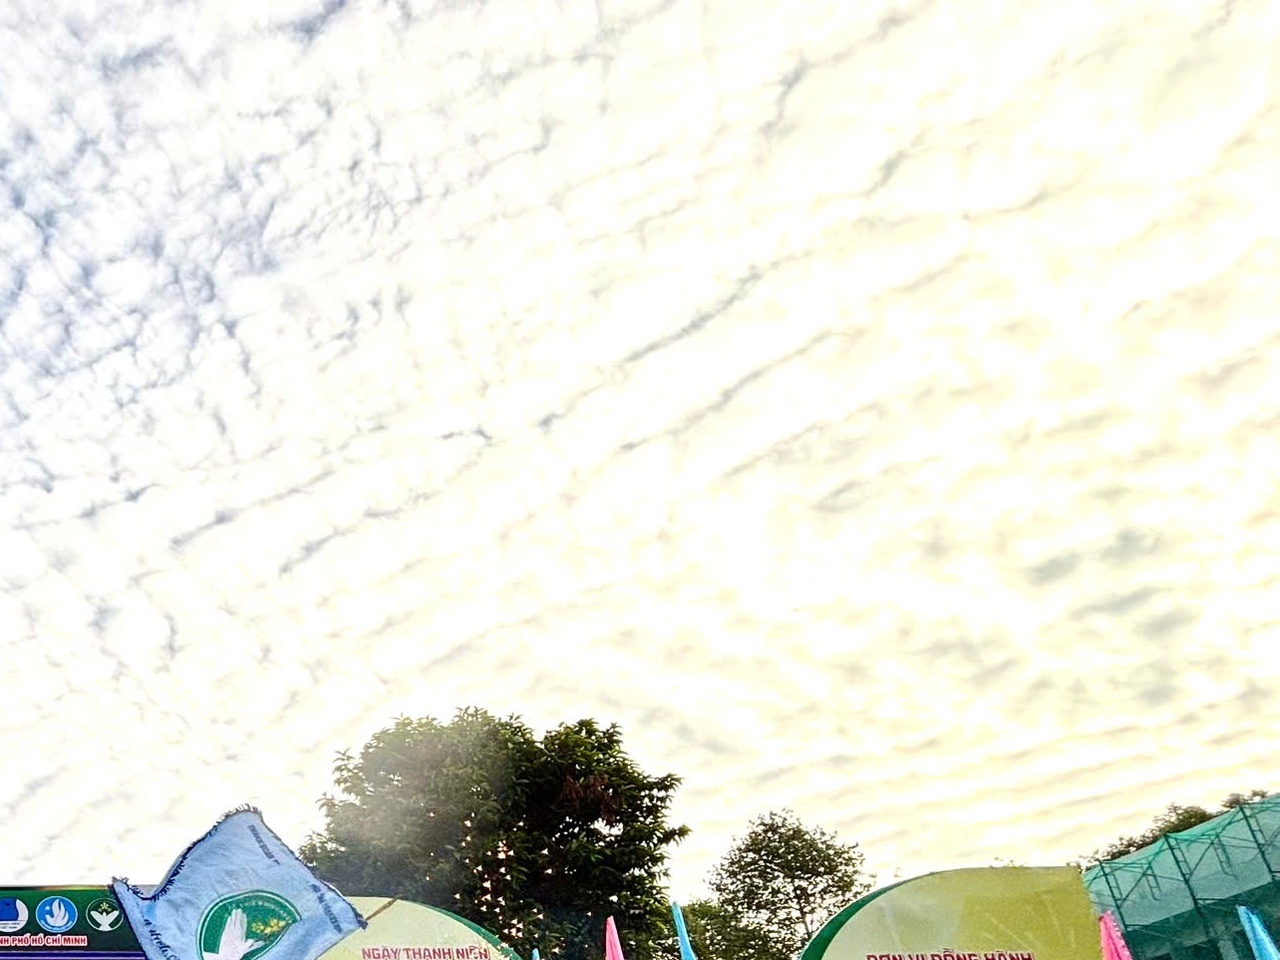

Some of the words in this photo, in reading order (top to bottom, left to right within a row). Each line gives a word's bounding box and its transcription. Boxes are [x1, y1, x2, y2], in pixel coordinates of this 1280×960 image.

[11, 933, 30, 946] PHỐ
[31, 933, 45, 946] HỒ
[45, 933, 61, 946] CHÍ
[62, 935, 87, 946] MINH
[362, 947, 401, 960] NGÀY
[404, 947, 453, 960] THANH
